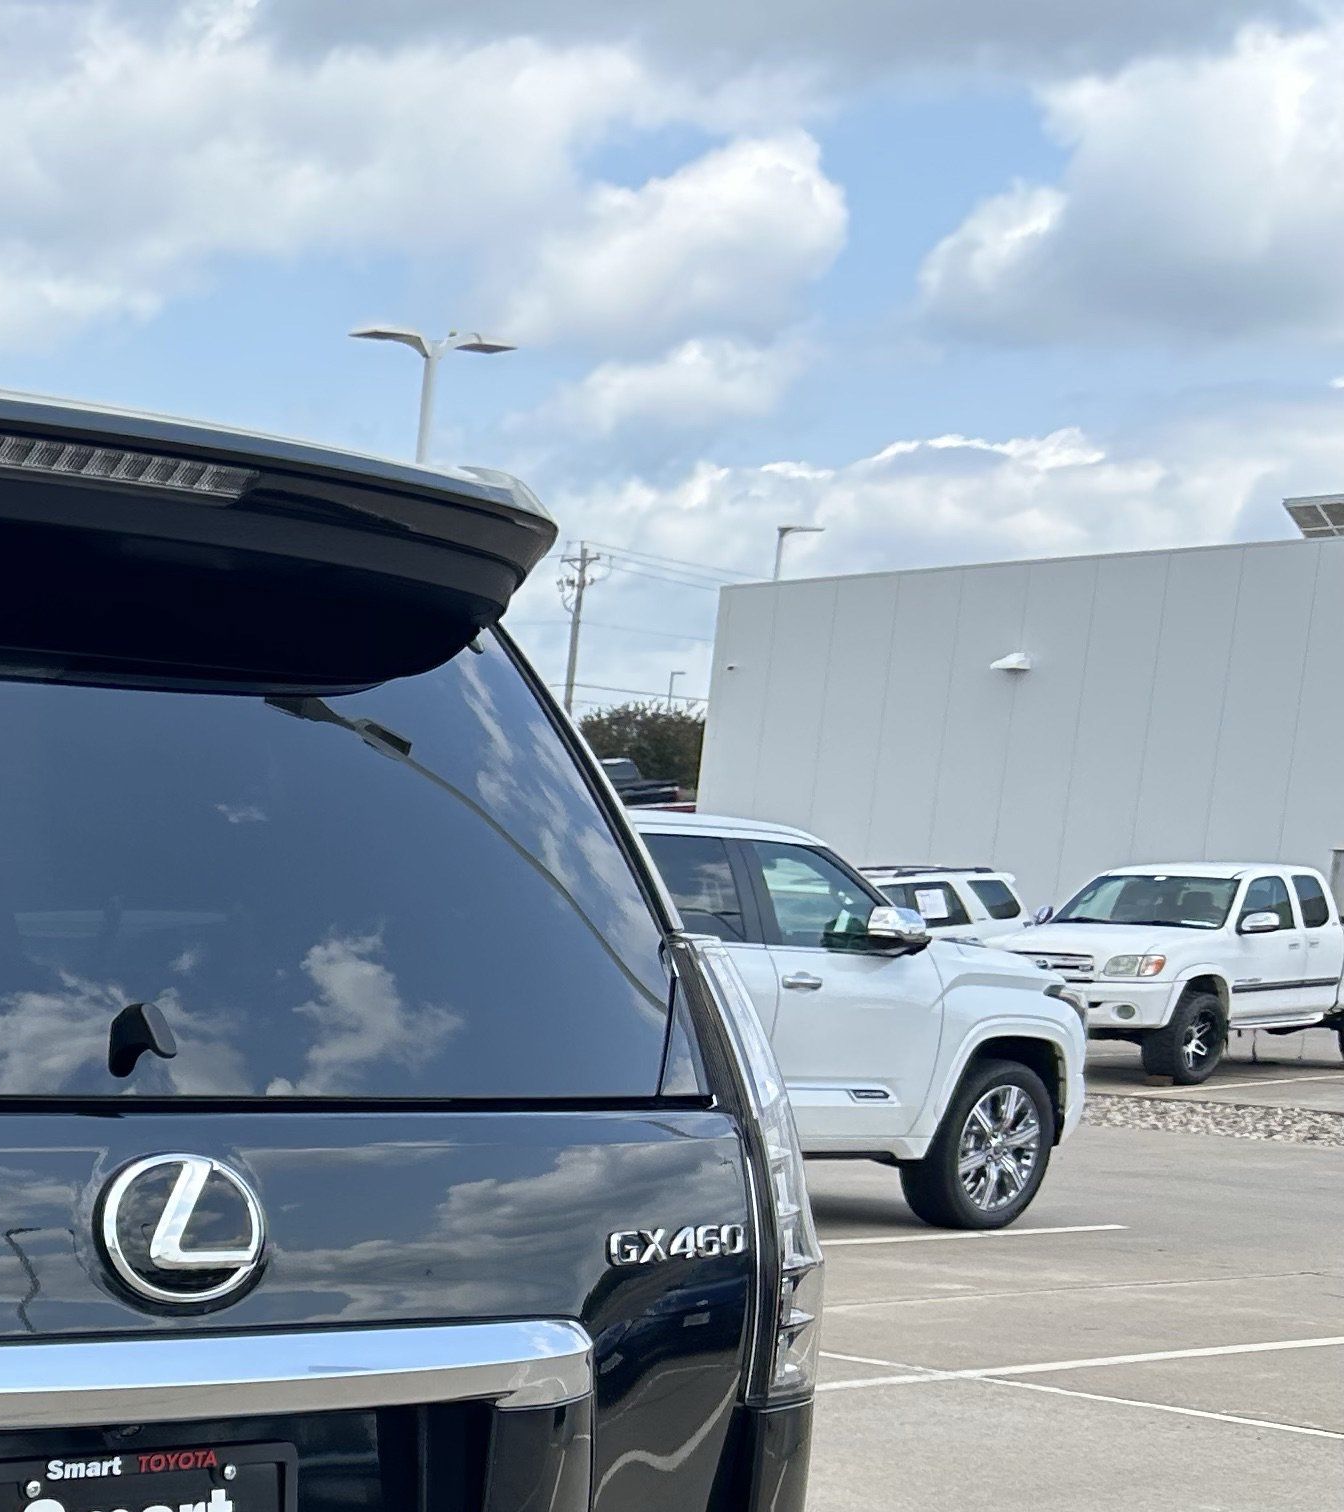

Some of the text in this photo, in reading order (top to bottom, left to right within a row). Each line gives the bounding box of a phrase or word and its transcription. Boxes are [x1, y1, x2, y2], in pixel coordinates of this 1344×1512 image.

[608, 1223, 745, 1266] GX460
[46, 1450, 218, 1480] Smart TOYOTA
